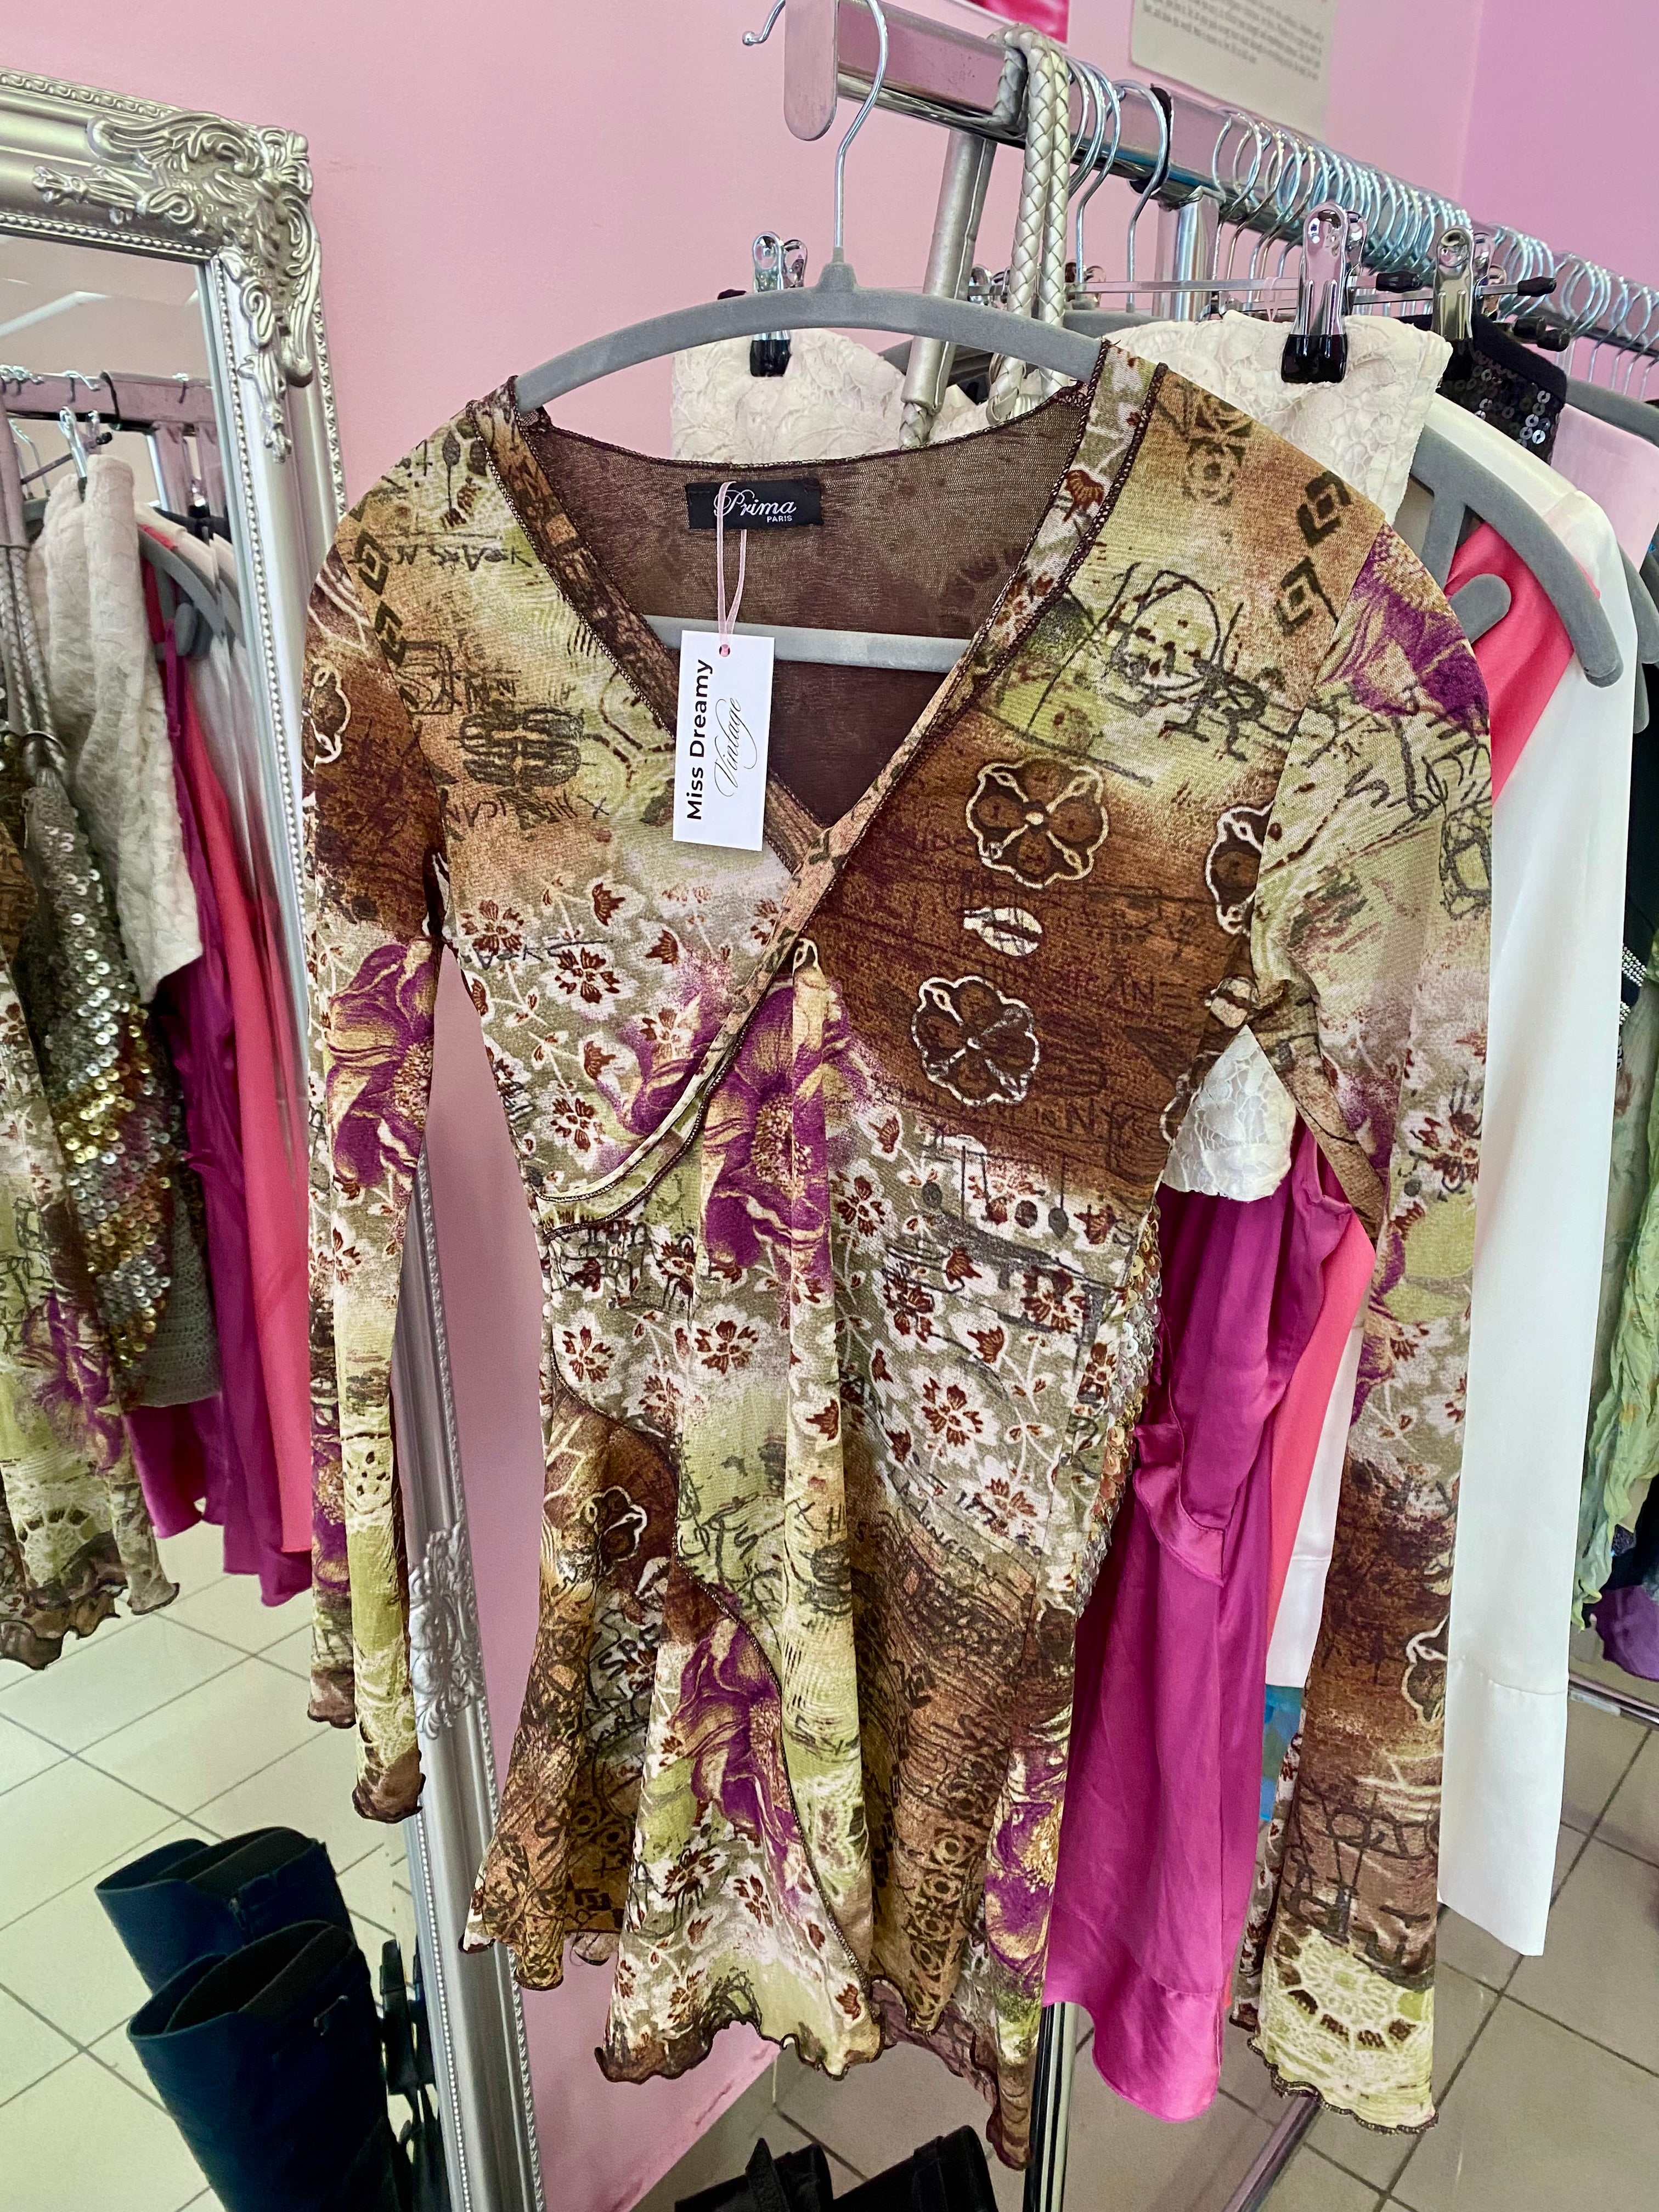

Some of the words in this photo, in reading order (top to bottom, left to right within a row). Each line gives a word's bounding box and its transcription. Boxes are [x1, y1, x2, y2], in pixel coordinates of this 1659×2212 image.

[714, 489, 797, 516] Prima
[690, 659, 713, 757] Dreamy
[714, 697, 757, 797] Vintage
[687, 767, 704, 820] Miss
